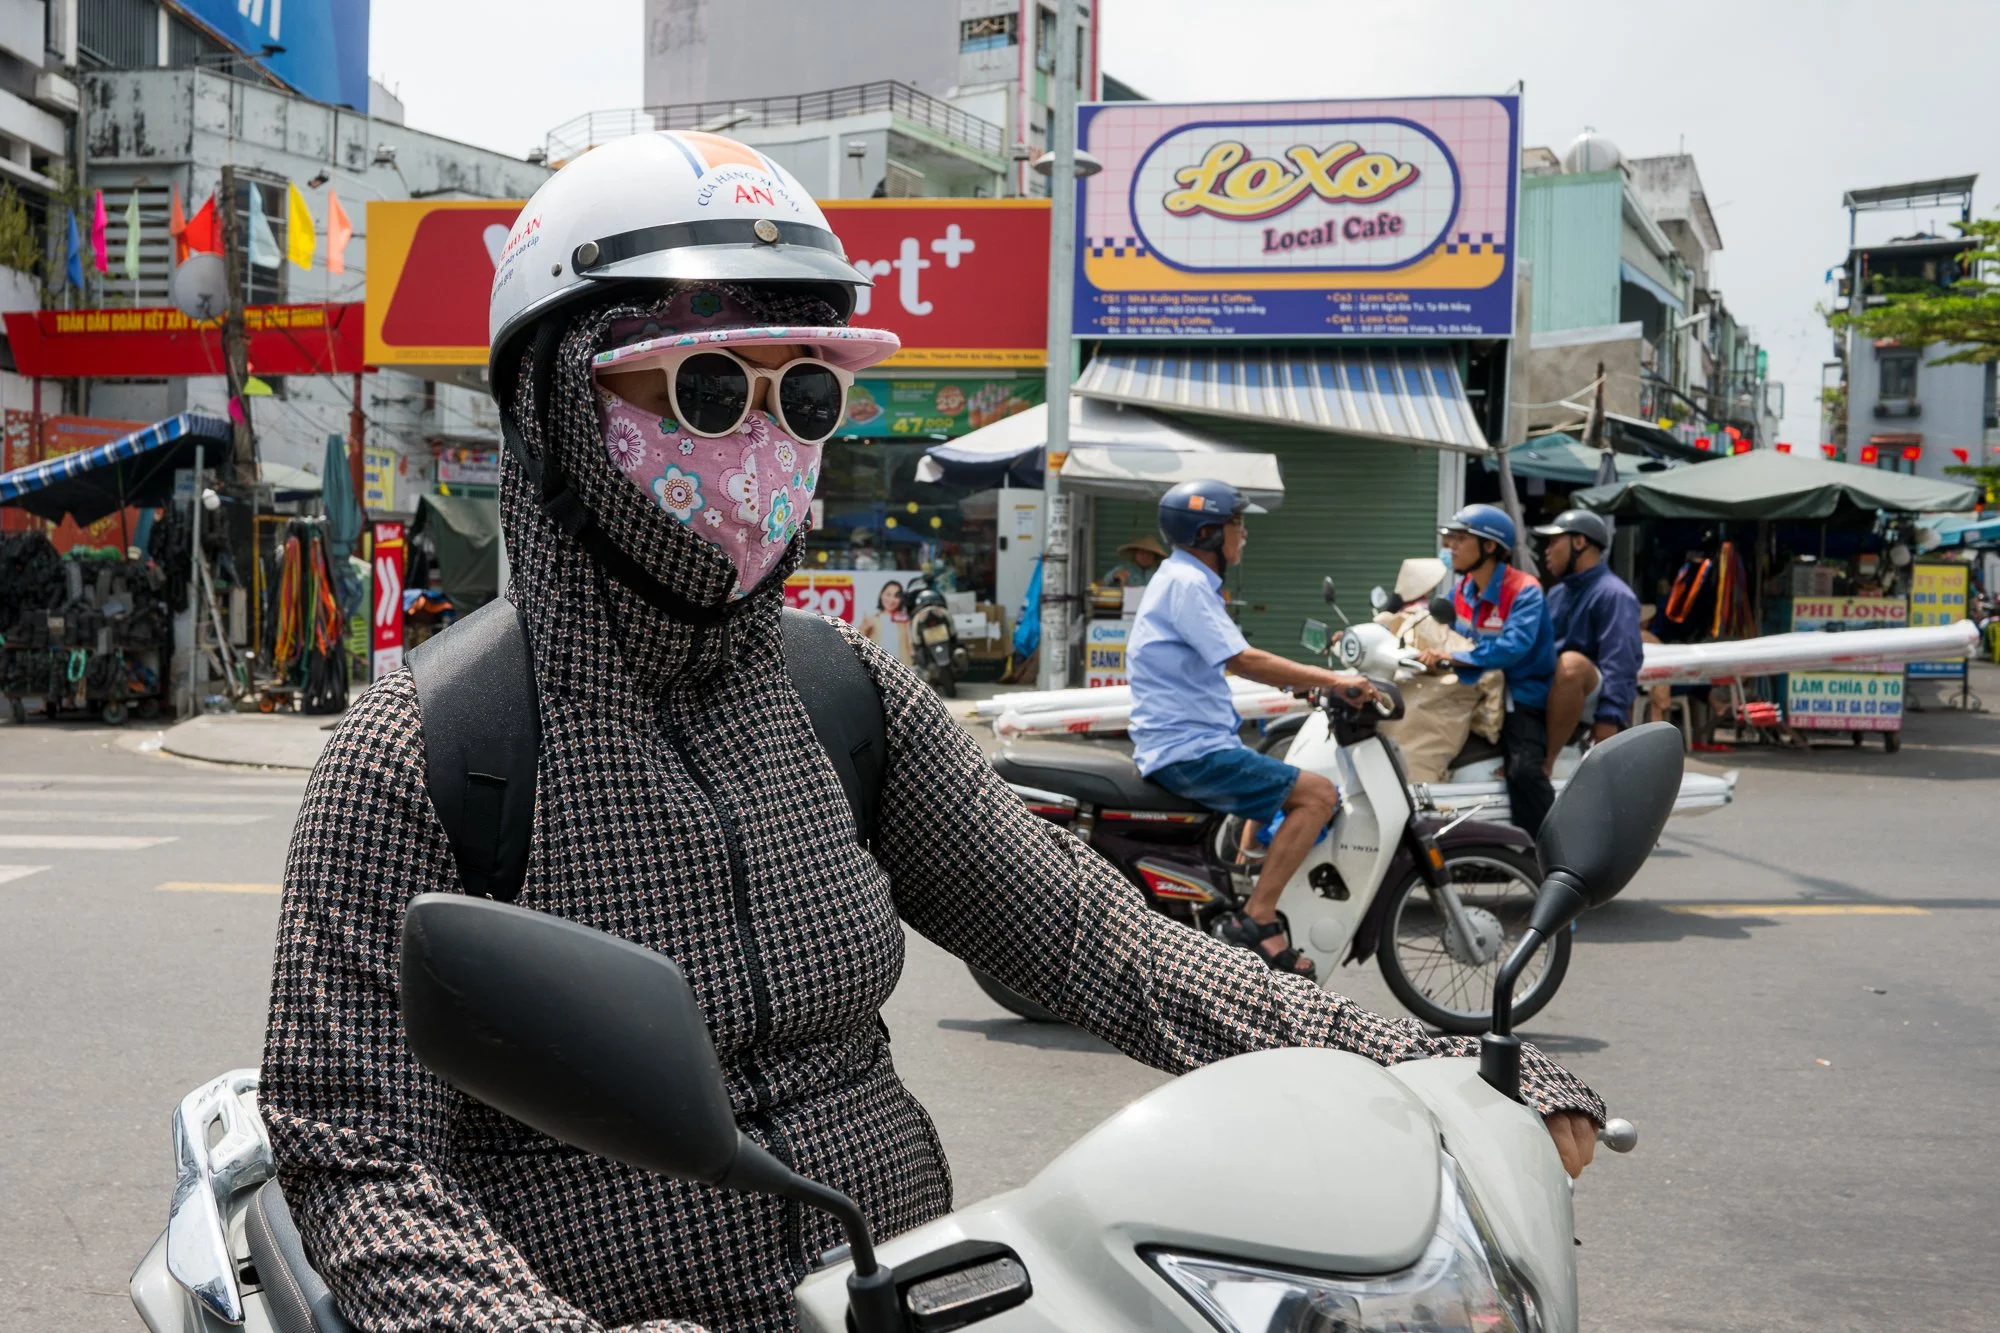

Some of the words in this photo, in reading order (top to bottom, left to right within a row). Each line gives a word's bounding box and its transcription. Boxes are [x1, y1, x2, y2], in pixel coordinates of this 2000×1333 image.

[735, 184, 775, 206] AN
[1263, 221, 1335, 255] Local
[1343, 213, 1403, 241] Cafe
[892, 417, 923, 433] 47
[1795, 603, 1835, 618] PHI
[1842, 603, 1904, 619] LONG
[1131, 811, 1168, 820] HONDA
